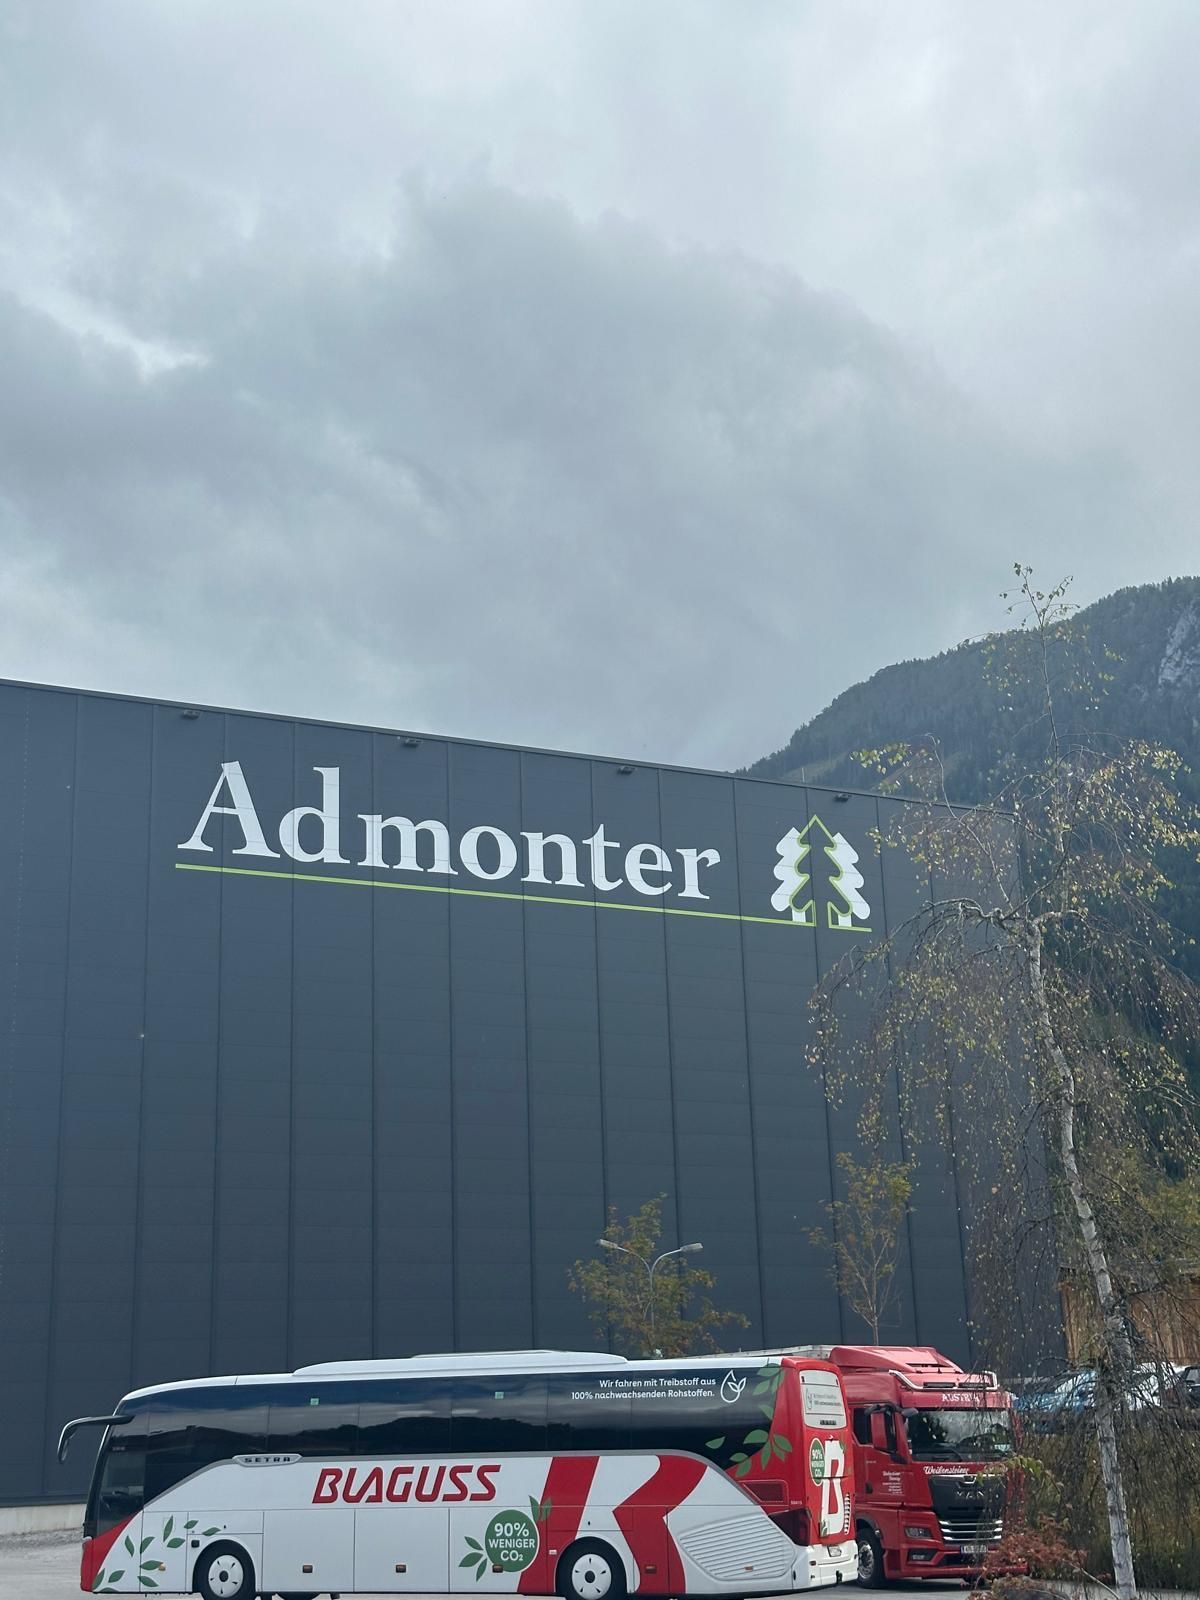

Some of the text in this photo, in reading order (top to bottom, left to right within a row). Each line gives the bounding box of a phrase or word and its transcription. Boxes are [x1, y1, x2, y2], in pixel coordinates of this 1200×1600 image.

[177, 761, 721, 900] Admonter
[599, 1377, 716, 1388] Wir fahren mit Treibstoff aus
[571, 1389, 715, 1400] 100% nachwachsenden Rohstoffen.
[811, 1449, 823, 1460] 90%
[311, 1464, 501, 1504] BLAGUSS
[494, 1522, 529, 1537] 90%
[488, 1538, 535, 1549] WENIGER
